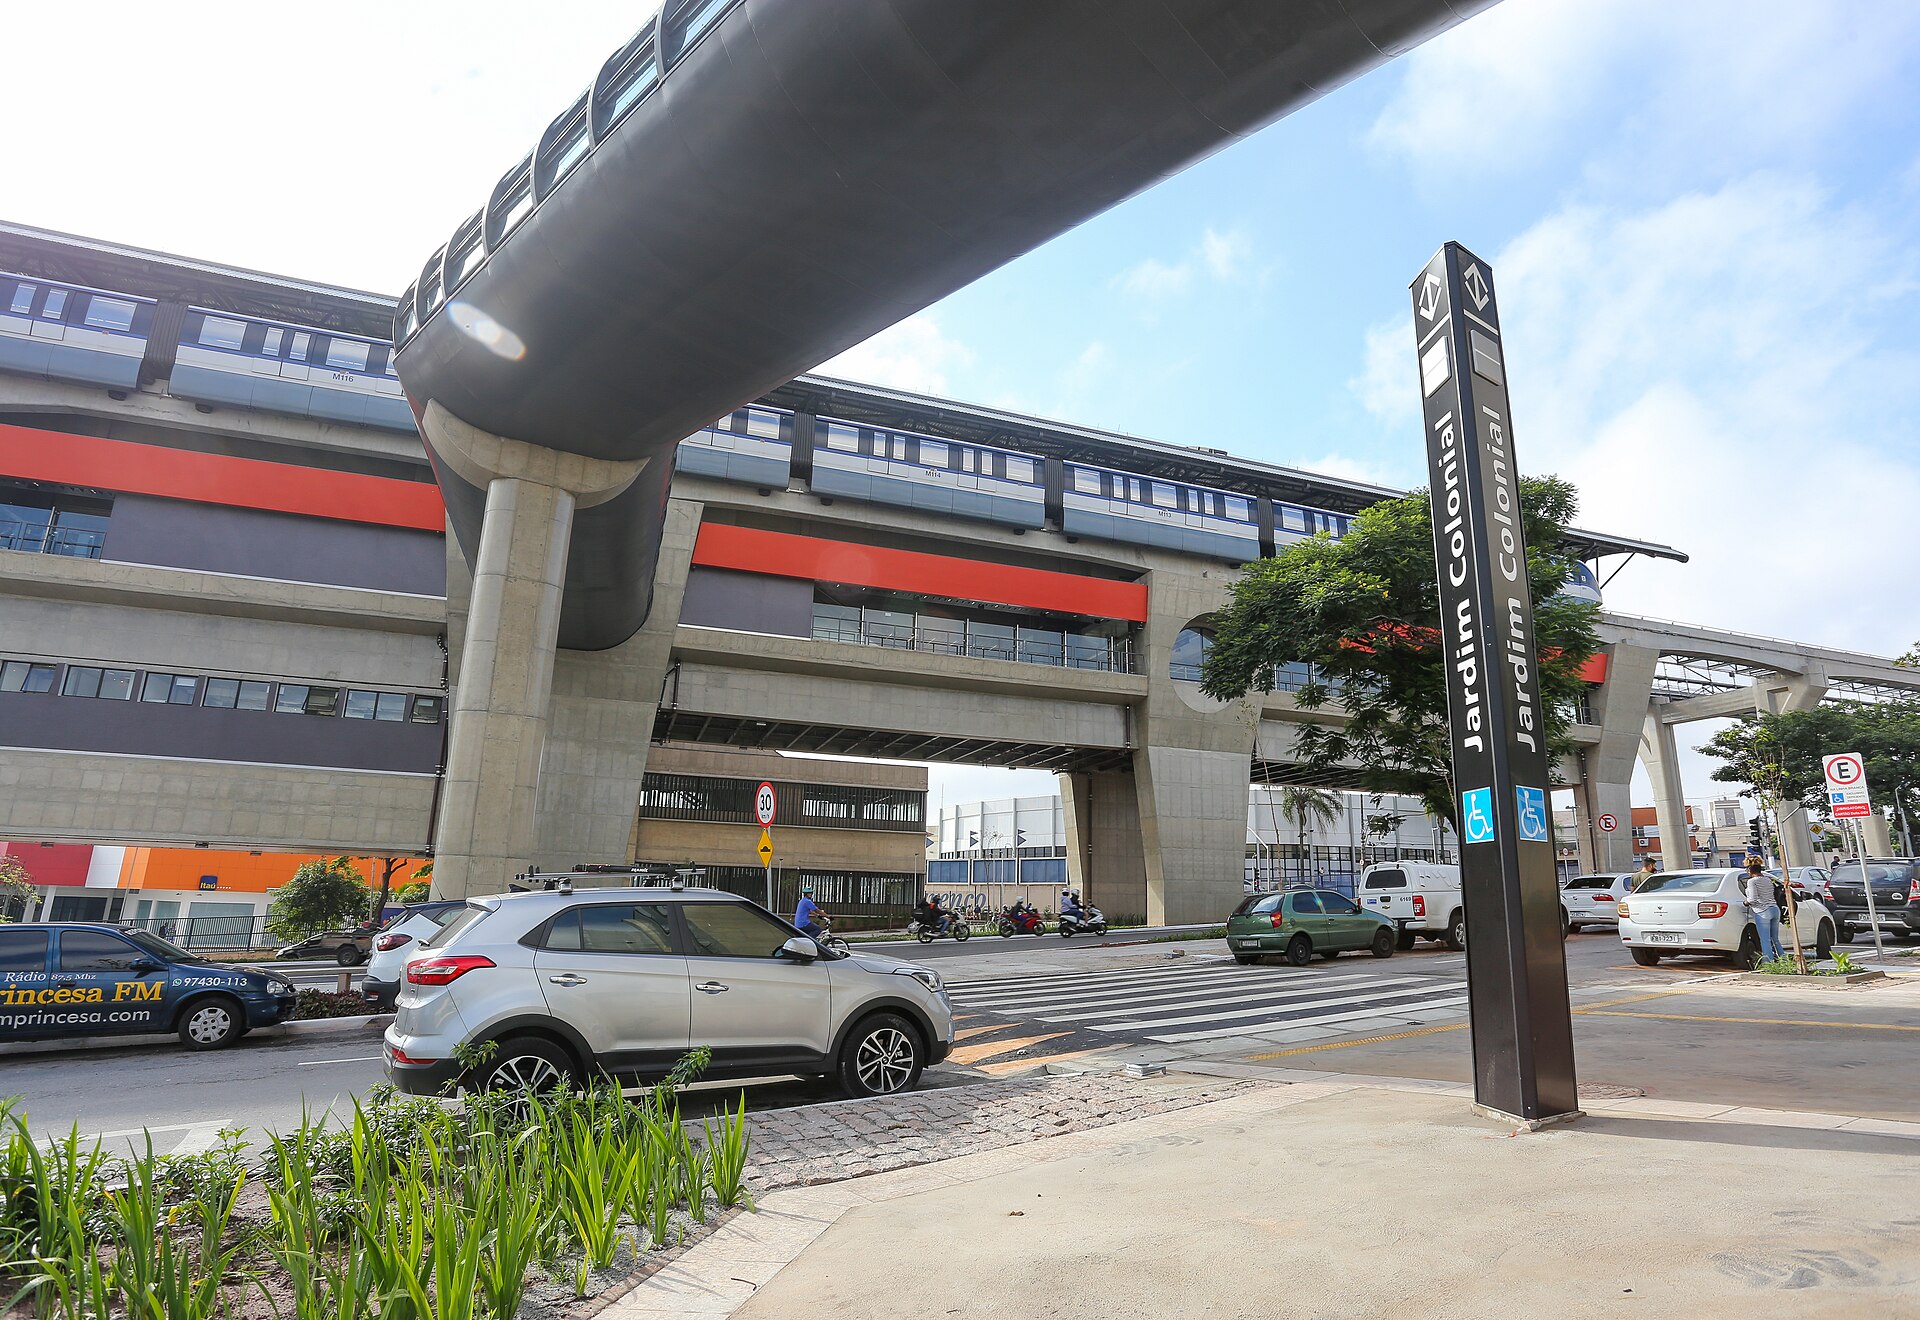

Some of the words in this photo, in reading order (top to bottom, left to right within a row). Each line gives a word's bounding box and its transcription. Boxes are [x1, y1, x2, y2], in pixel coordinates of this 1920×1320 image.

[332, 373, 354, 382] M116
[1434, 410, 1467, 588] Colonial
[1482, 405, 1518, 582] Colonial
[1456, 598, 1483, 753] Jardim
[1504, 597, 1536, 753] Jardim
[1837, 762, 1851, 779] E
[760, 794, 772, 811] 30
[4, 971, 47, 982] Rádio
[184, 977, 248, 987] 97430-113
[111, 981, 166, 1002] FM
